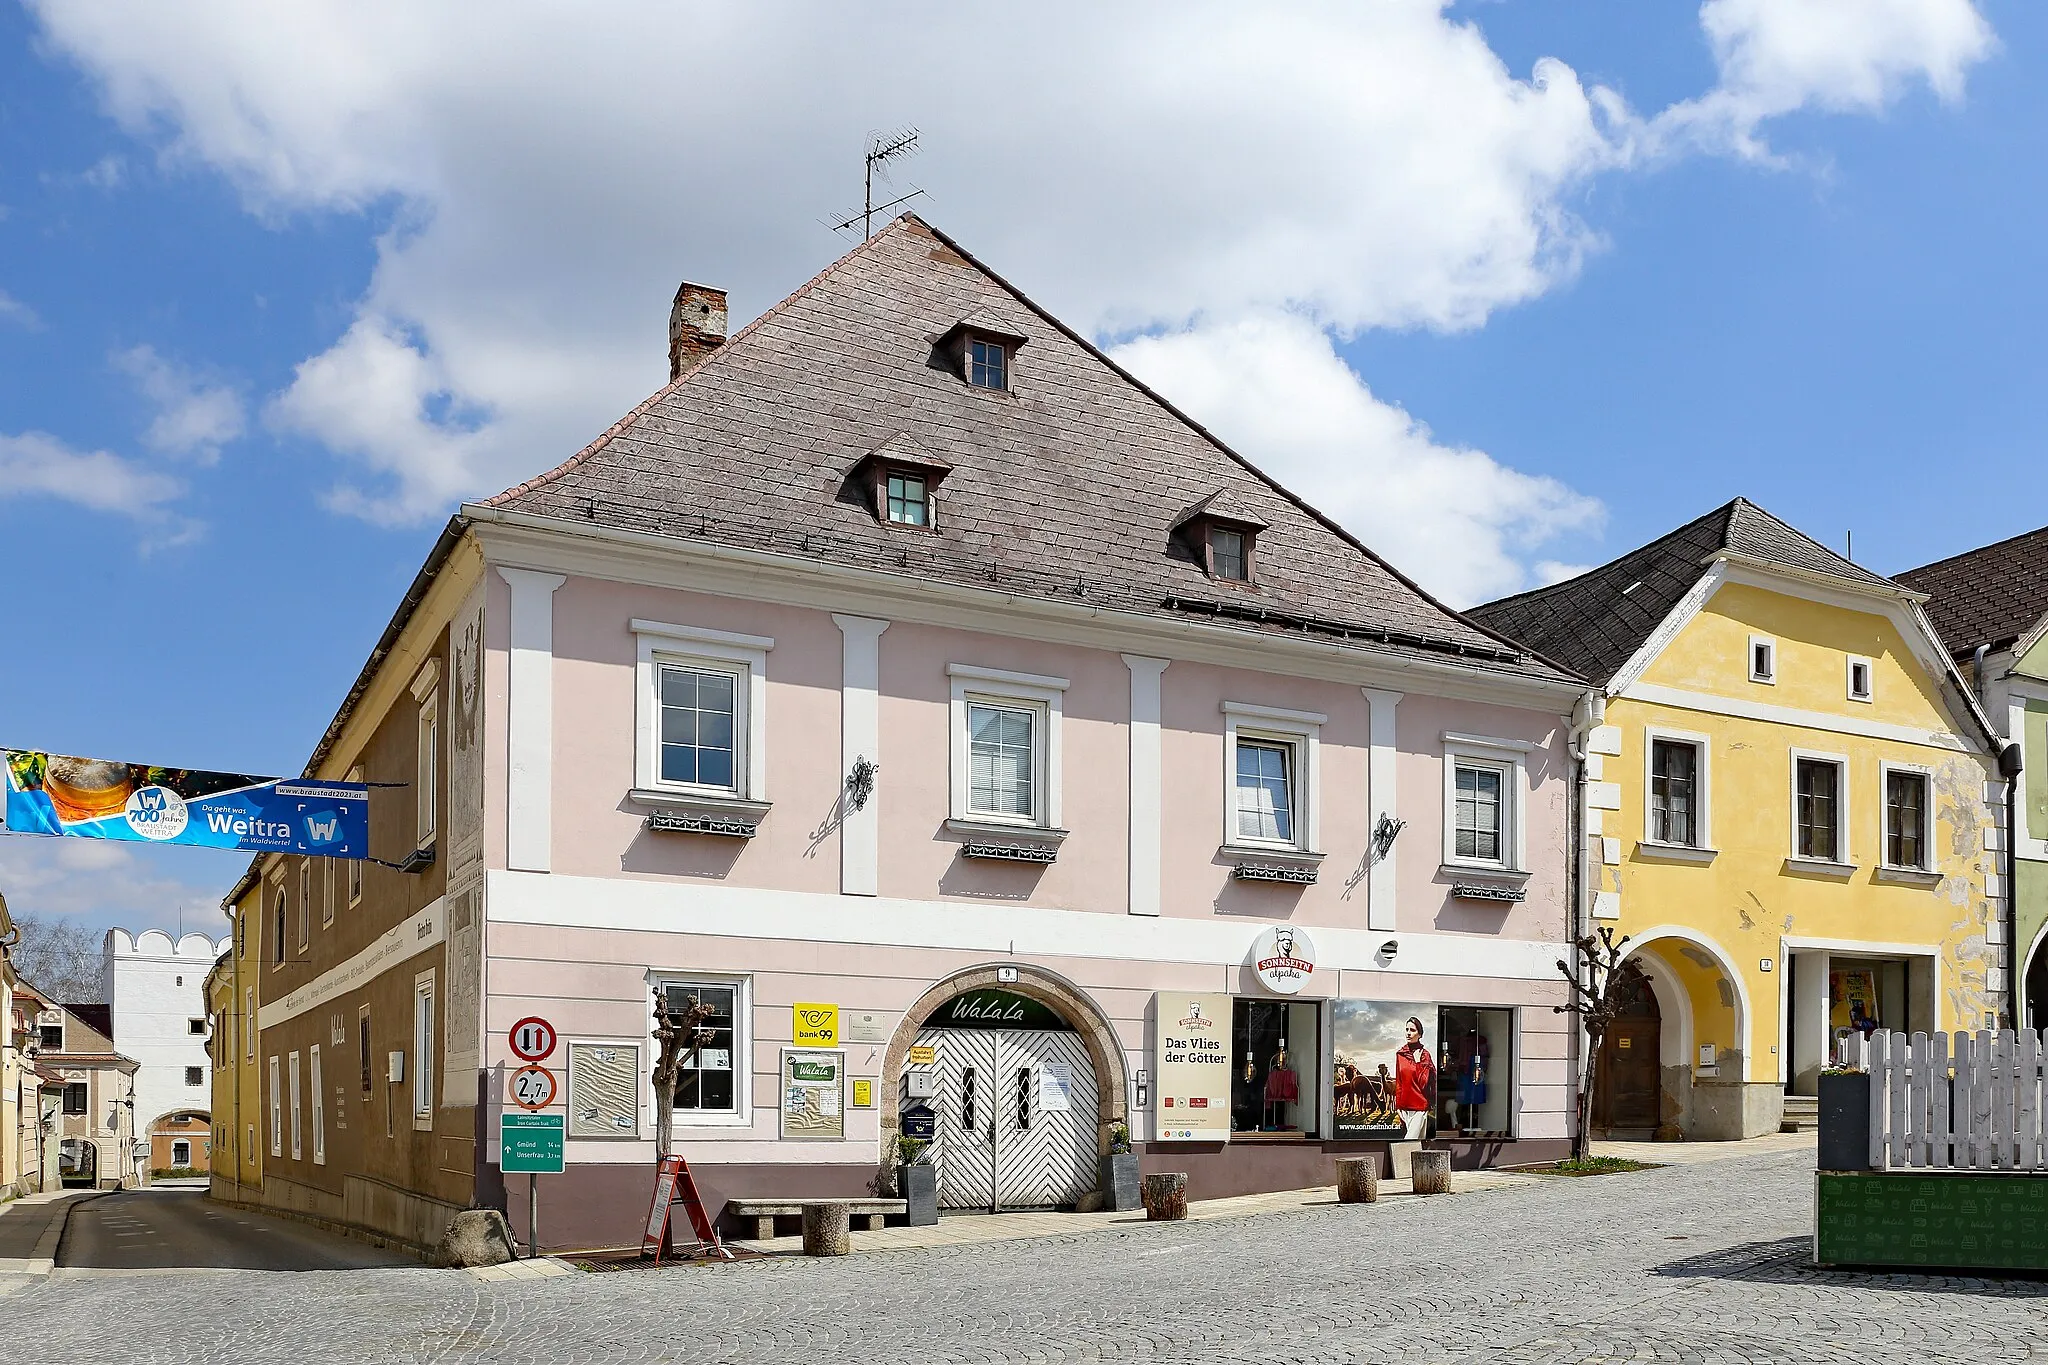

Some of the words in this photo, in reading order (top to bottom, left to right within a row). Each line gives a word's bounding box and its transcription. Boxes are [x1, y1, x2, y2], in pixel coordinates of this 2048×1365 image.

[279, 787, 362, 799] www.braustadt2021.at
[202, 804, 213, 812] Da
[213, 805, 231, 814] geht
[129, 809, 159, 822] 700
[160, 811, 184, 824] Jahre
[137, 822, 177, 831] BRAUSTADT
[207, 813, 291, 838] Weitra
[141, 828, 173, 837] WEITRA
[250, 837, 291, 846] Waldviertel
[1261, 958, 1310, 971] SONNSEITN
[1004, 968, 1010, 978] 9
[1269, 966, 1302, 982] alpaka
[952, 997, 1024, 1020] WaLaLa
[1165, 1037, 1187, 1049] Das
[1189, 1037, 1220, 1050] Vlies
[1165, 1051, 1186, 1063] der
[1188, 1051, 1226, 1064] Götter
[799, 1064, 828, 1075] WaLaLa
